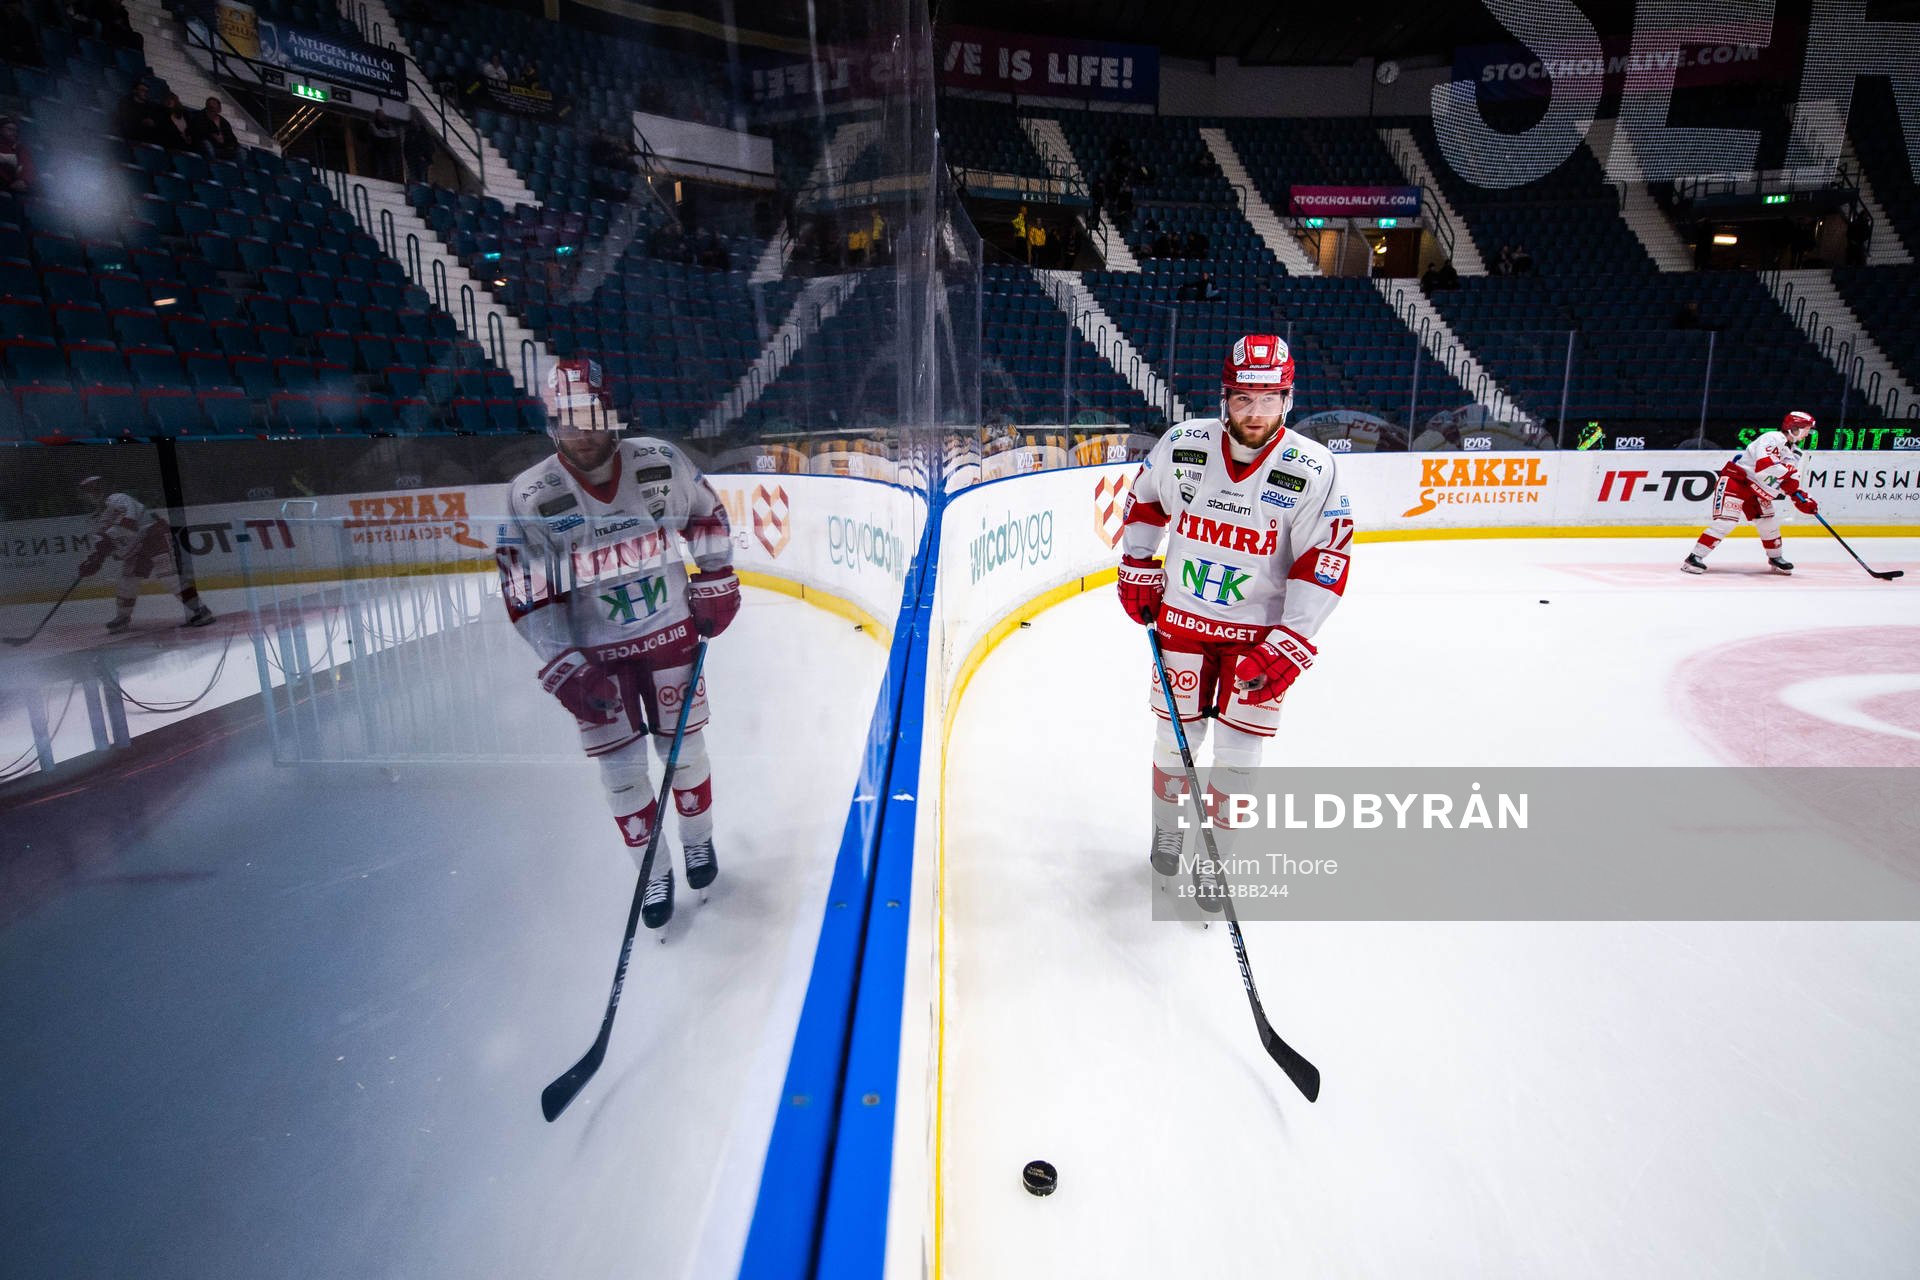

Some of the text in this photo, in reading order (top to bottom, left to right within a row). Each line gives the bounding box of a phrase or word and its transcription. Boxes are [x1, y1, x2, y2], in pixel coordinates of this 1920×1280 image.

[288, 30, 396, 73] ÄNTLIGEN. KALL ÖL
[1481, 45, 1760, 83] STOCKHOLMLIVE.COM
[999, 46, 1033, 81] IS
[1047, 52, 1134, 89] LIFE!
[1293, 195, 1416, 206] STOCKHOLMLIVE.COM
[1185, 429, 1210, 440] SCA
[1464, 437, 1492, 447] RYDS
[1616, 436, 1645, 447] RYDS
[1298, 454, 1323, 475] SCA
[1419, 458, 1548, 487] KAKEL
[1808, 470, 1920, 488] MENSW
[1597, 470, 1722, 502] IT-TO
[1206, 498, 1251, 516] stadium
[1401, 488, 1539, 518] SPECIALISTEN
[970, 509, 1053, 585] wicabygg
[1176, 509, 1278, 556] TIMRÅ
[1326, 518, 1354, 550] 17
[1118, 569, 1163, 585] AUER
[1182, 557, 1253, 606] NHK
[1166, 610, 1257, 642] BILBOLAGET
